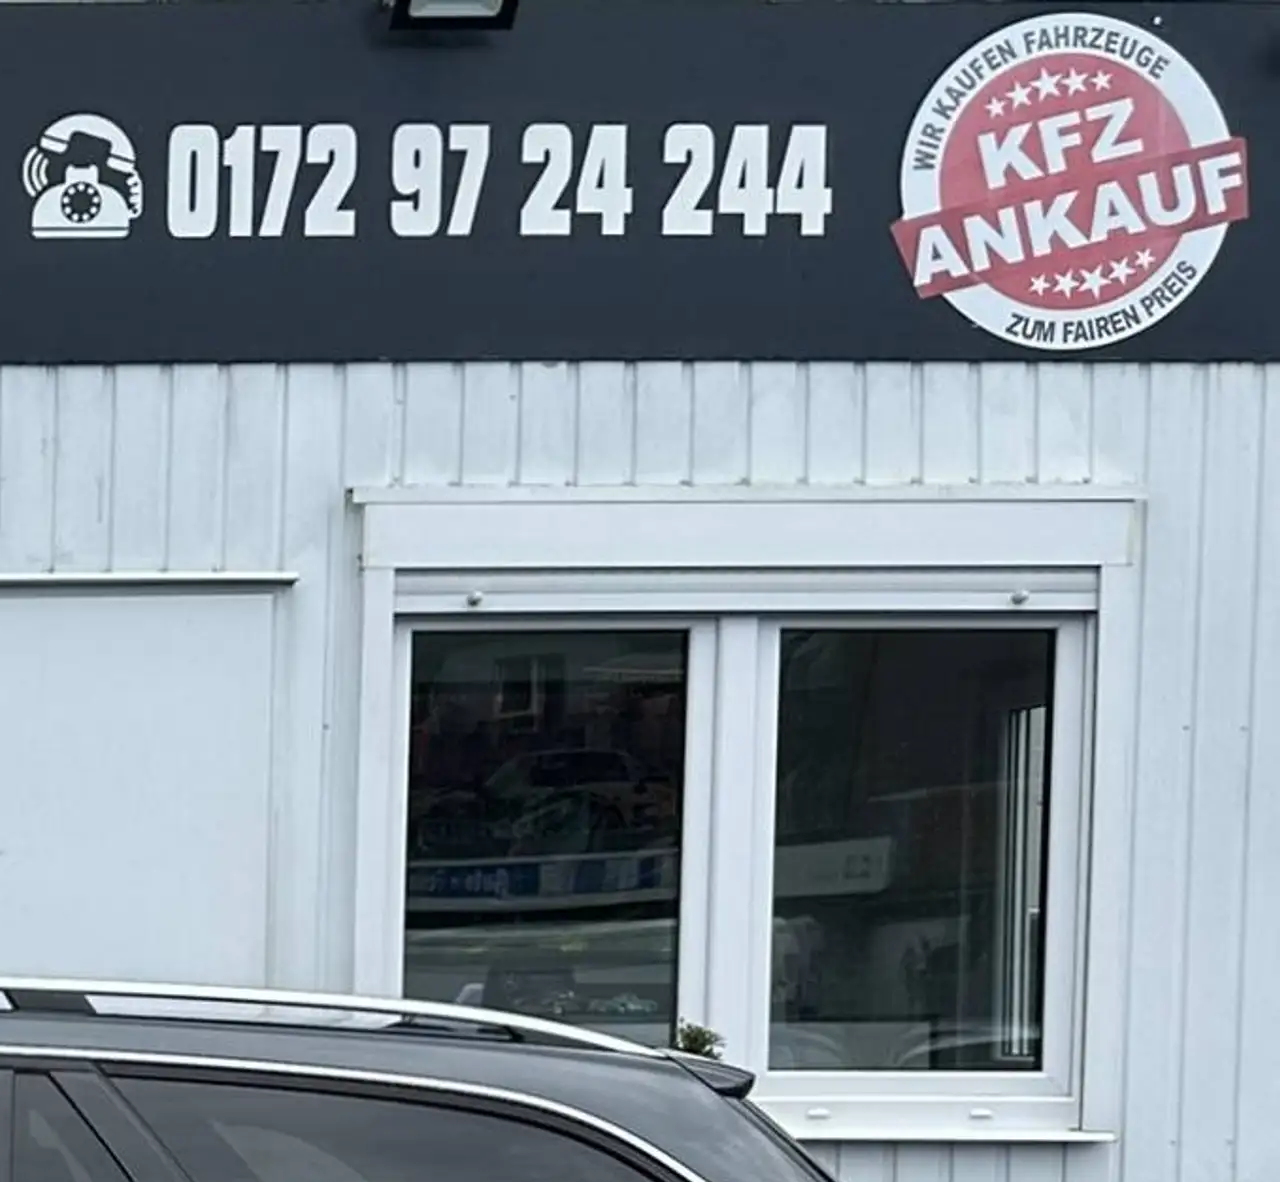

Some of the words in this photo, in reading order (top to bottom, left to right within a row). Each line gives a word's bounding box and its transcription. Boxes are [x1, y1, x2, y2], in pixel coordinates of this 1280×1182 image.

[913, 123, 945, 171] WIR
[931, 39, 1017, 119] KAUFEN
[1024, 25, 1170, 80] FAHRZEUGE
[977, 97, 1143, 190] KFZ
[167, 123, 357, 238] 0172
[390, 123, 491, 237] 97
[519, 124, 632, 236] 24
[661, 124, 832, 236] 244
[914, 152, 1243, 286] ANKAUF
[1006, 313, 1055, 342] ZUM
[1062, 308, 1141, 345] FAIREN
[1144, 259, 1198, 318] PREIS
